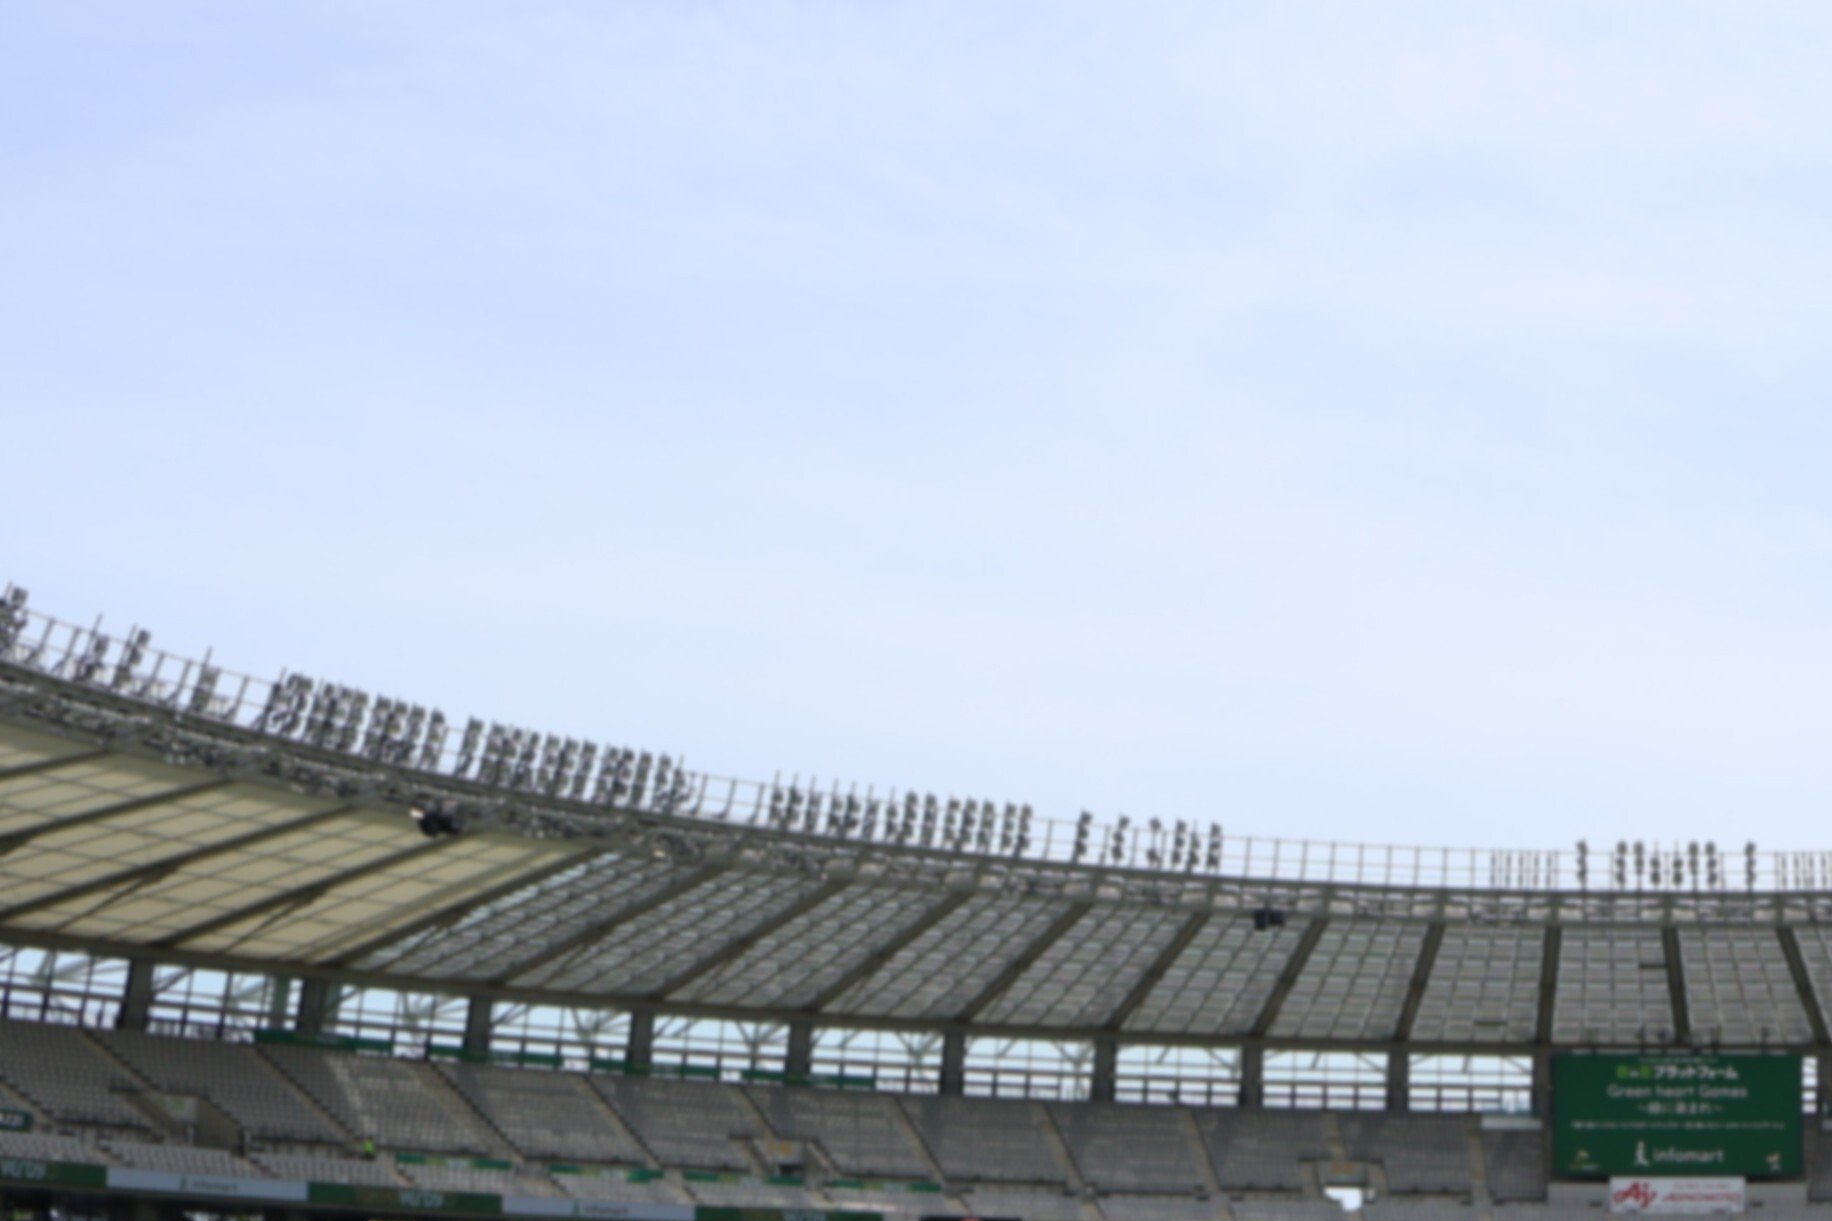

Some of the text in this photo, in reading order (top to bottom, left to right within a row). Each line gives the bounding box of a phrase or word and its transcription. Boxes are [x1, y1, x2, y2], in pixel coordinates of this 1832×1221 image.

[1607, 1084, 1748, 1099] Green heart Games
[1652, 1147, 1726, 1164] infomart
